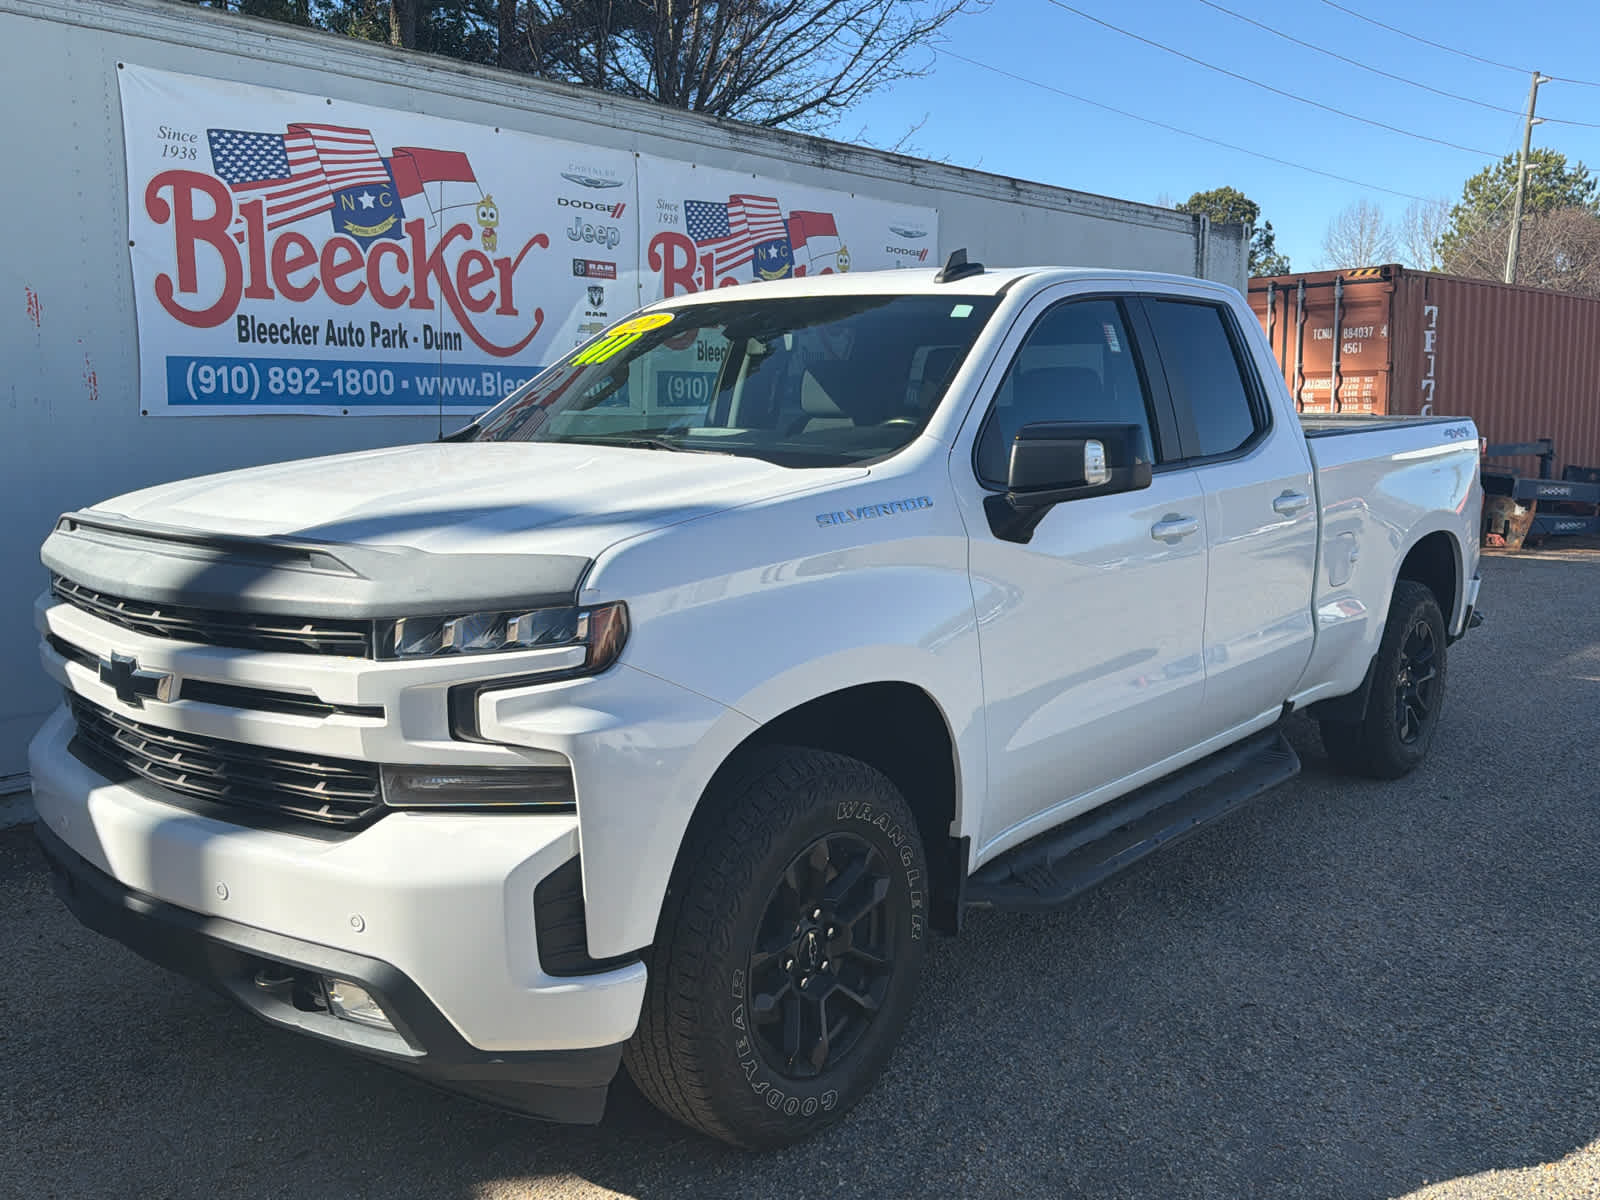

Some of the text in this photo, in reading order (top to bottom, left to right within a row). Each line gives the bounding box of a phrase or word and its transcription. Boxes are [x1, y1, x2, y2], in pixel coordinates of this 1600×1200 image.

[157, 125, 198, 143] Since
[162, 144, 197, 161] 1938
[341, 192, 393, 211] N C
[557, 198, 617, 213] DODGE
[656, 198, 679, 212] Since
[567, 216, 620, 250] Jeep
[758, 246, 788, 261] N C
[885, 246, 922, 257] DODGE
[145, 170, 549, 357] Bleecker
[588, 263, 615, 272] RAM
[237, 314, 319, 346] Bleecker
[325, 319, 366, 348] Auto
[370, 321, 409, 349] Park
[423, 324, 463, 351] Dunn
[1312, 327, 1333, 340] TCNU
[1343, 342, 1363, 354] 45G1
[186, 360, 261, 400] (910)
[268, 365, 395, 397] 892-1800
[668, 375, 709, 403] (910)
[815, 496, 934, 528] SILVERADO
[837, 800, 921, 940] WRANGLER
[731, 968, 839, 1116] GOODYEAR
